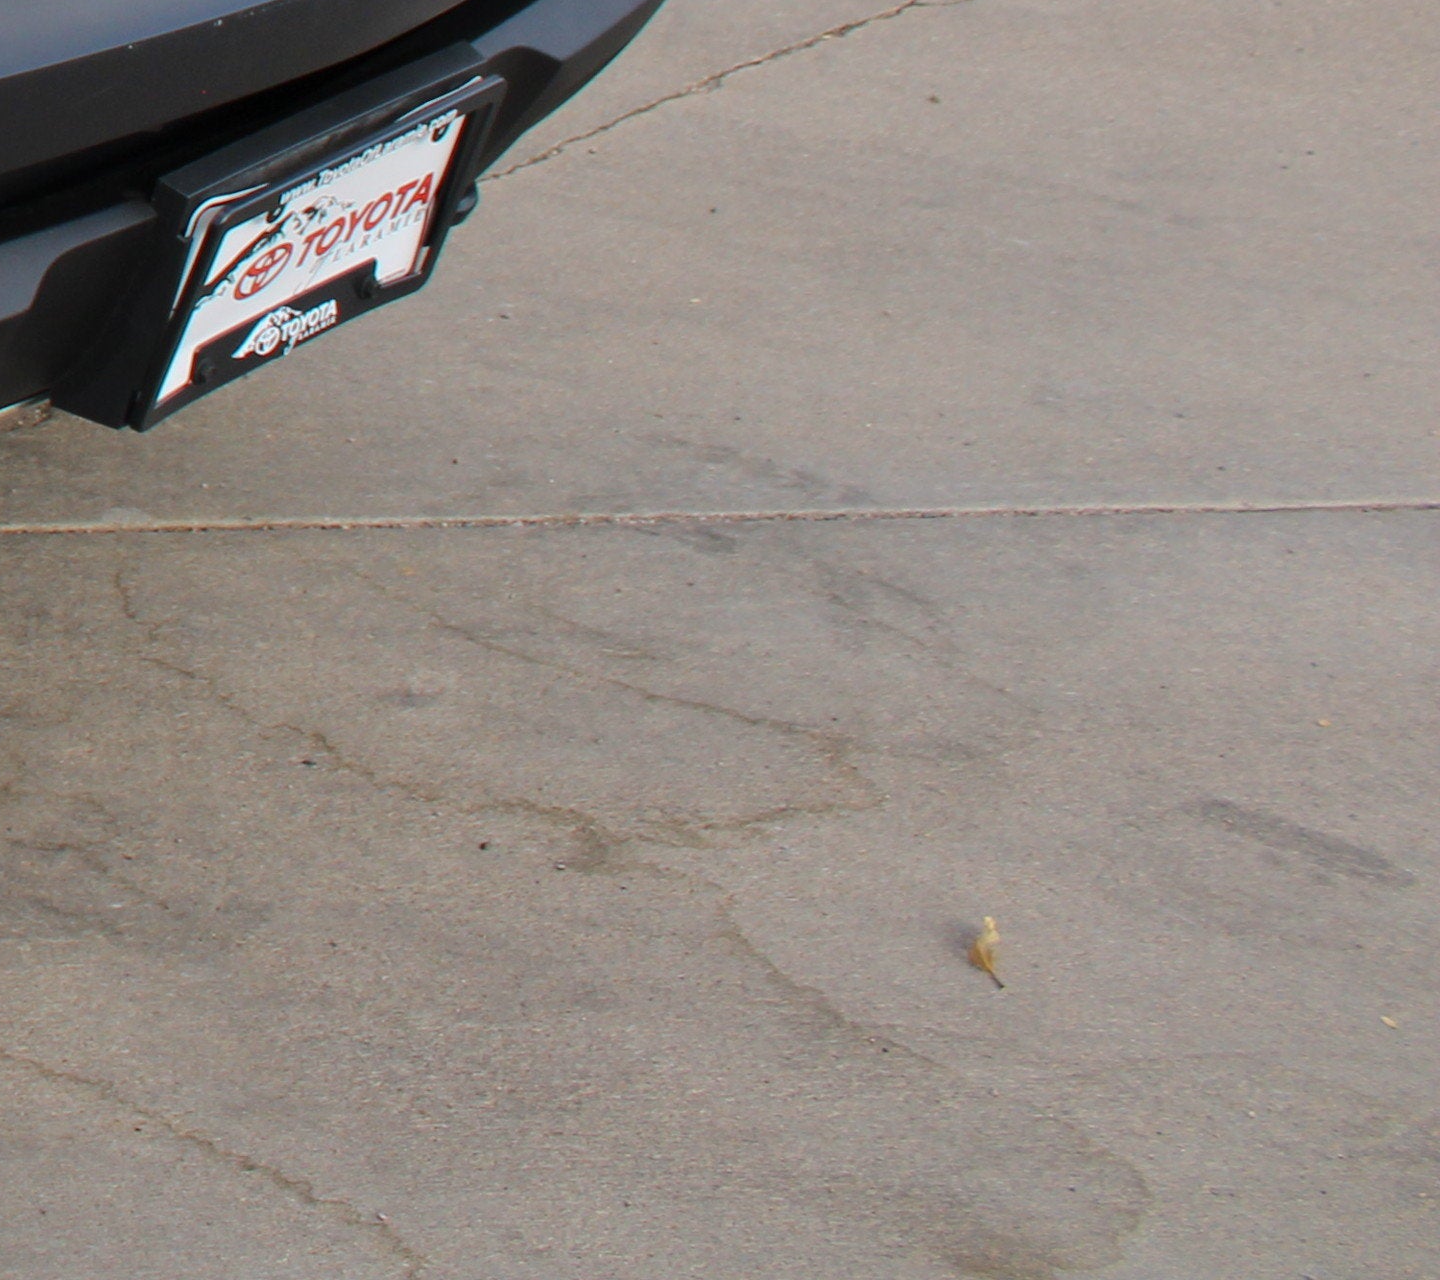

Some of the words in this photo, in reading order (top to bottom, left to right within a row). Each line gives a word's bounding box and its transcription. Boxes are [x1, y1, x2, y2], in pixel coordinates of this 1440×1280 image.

[296, 171, 434, 269] TOYOTA
[331, 208, 427, 263] LARAMIE
[281, 298, 338, 342] TOYOTA
